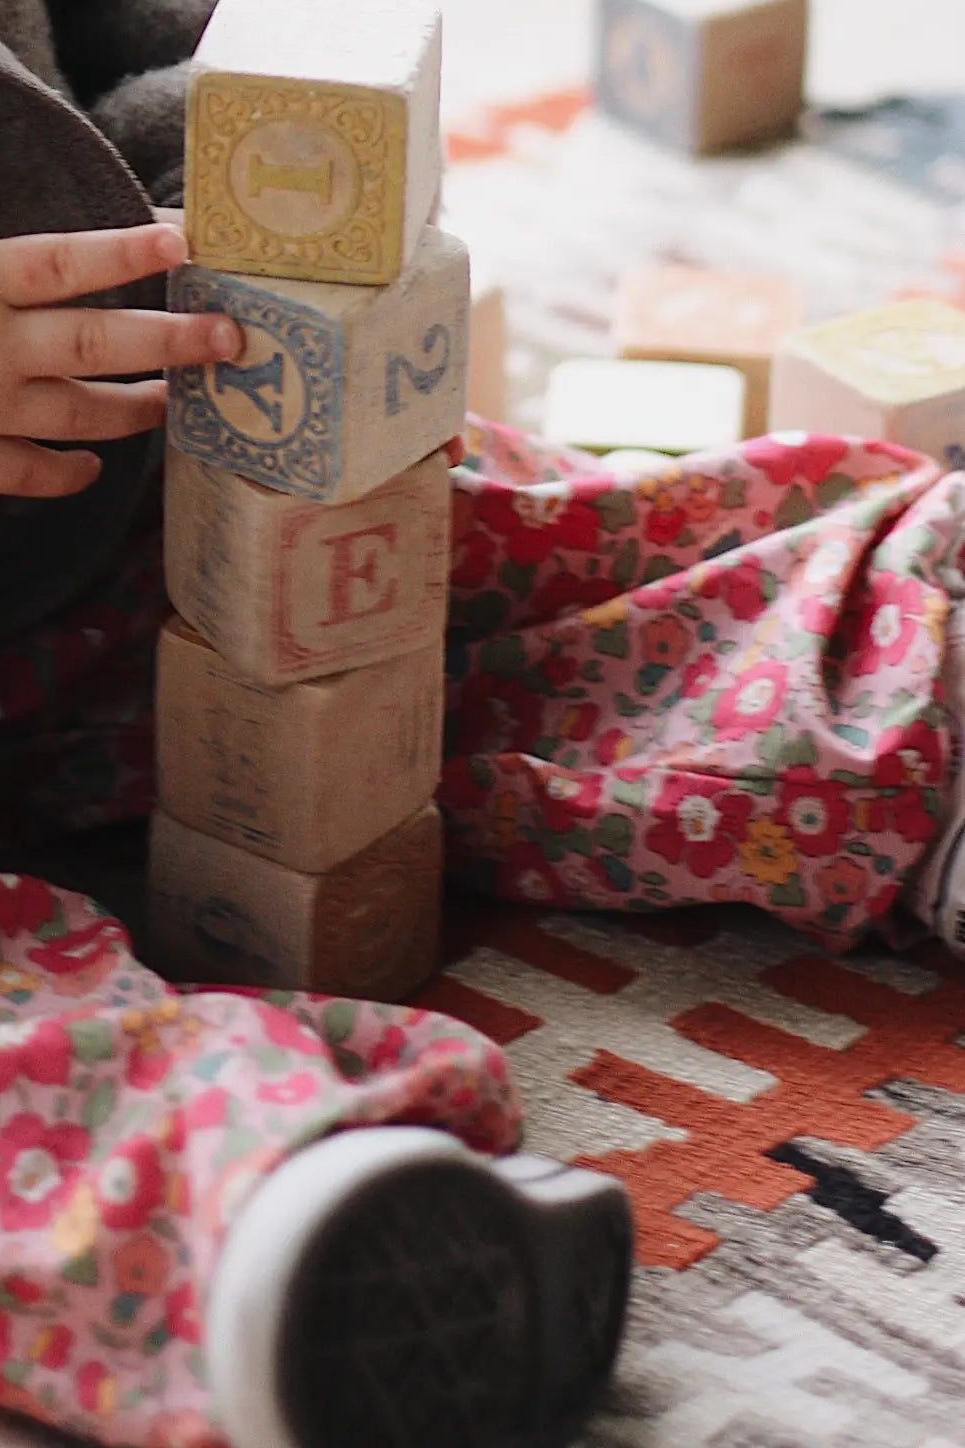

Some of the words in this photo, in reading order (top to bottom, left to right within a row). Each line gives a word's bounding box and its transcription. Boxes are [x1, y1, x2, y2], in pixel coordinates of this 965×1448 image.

[247, 154, 333, 205] I
[216, 352, 283, 432] Y
[385, 323, 450, 417] 2
[317, 523, 398, 626] E
